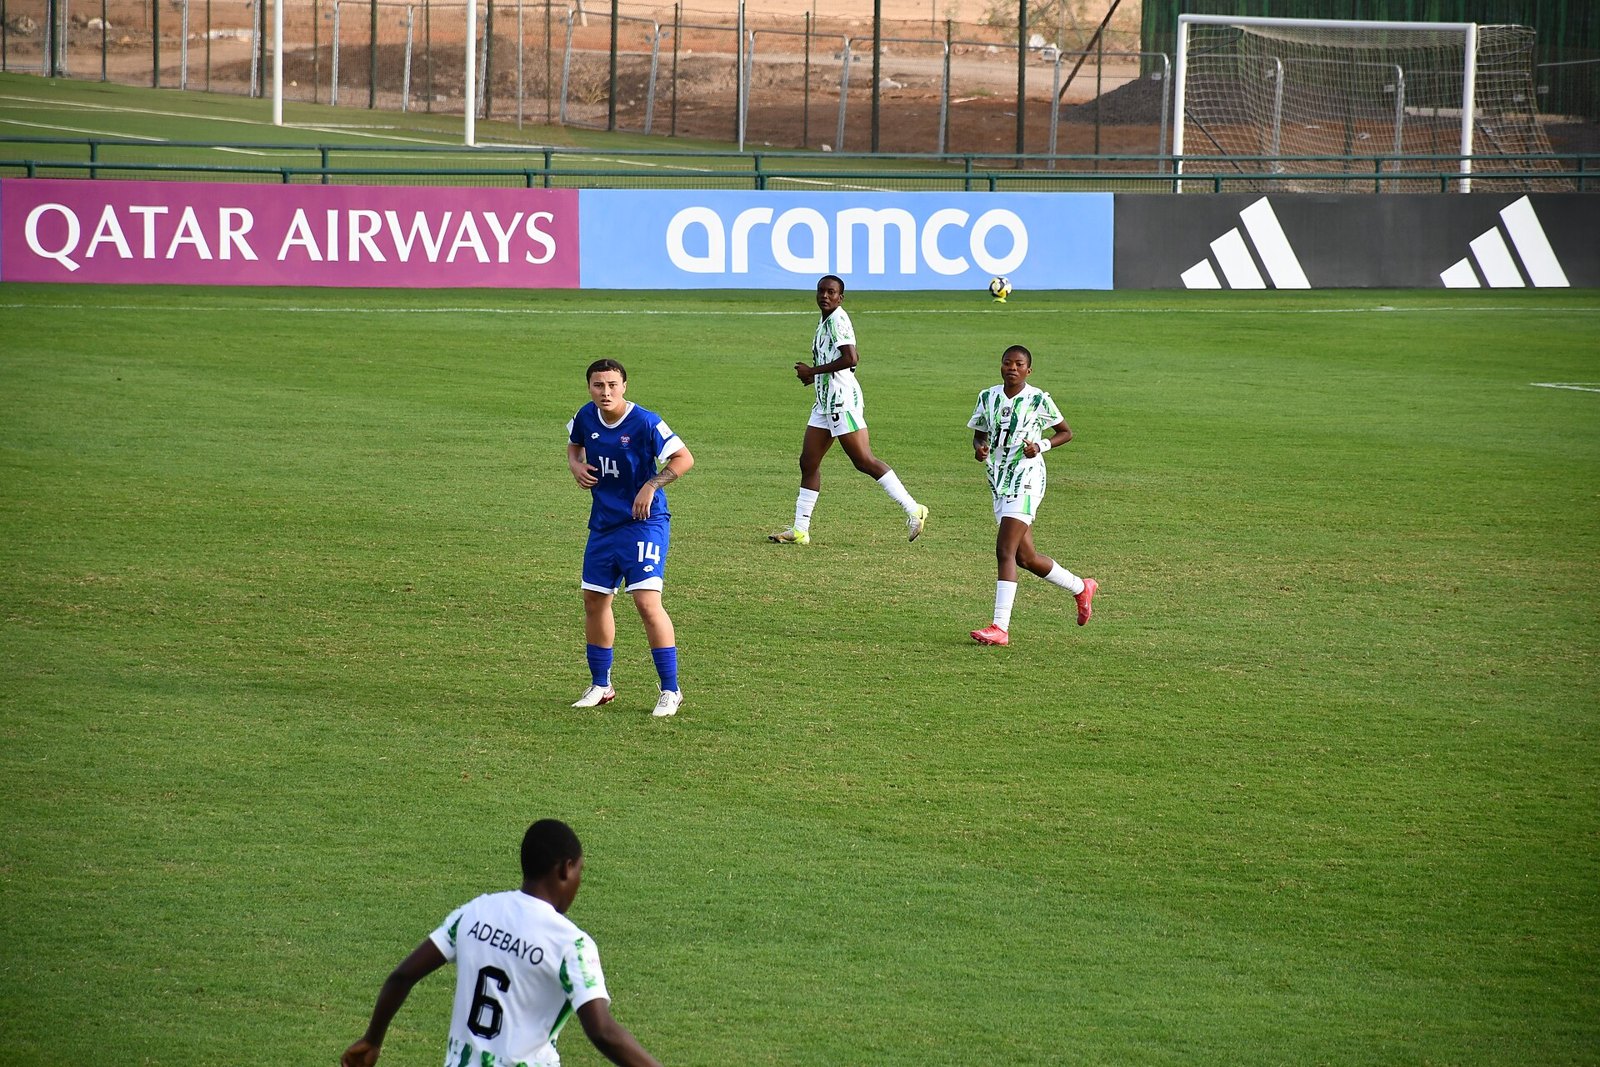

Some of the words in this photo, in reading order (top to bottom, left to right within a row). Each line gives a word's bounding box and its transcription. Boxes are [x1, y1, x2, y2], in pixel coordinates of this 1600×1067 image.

[24, 203, 258, 272] QATAR
[277, 207, 557, 265] AIRWAYS
[666, 206, 1029, 275] aramco
[598, 456, 619, 478] 14
[637, 541, 660, 565] 14
[467, 920, 544, 966] ADEBAYO
[466, 965, 511, 1041] 6
